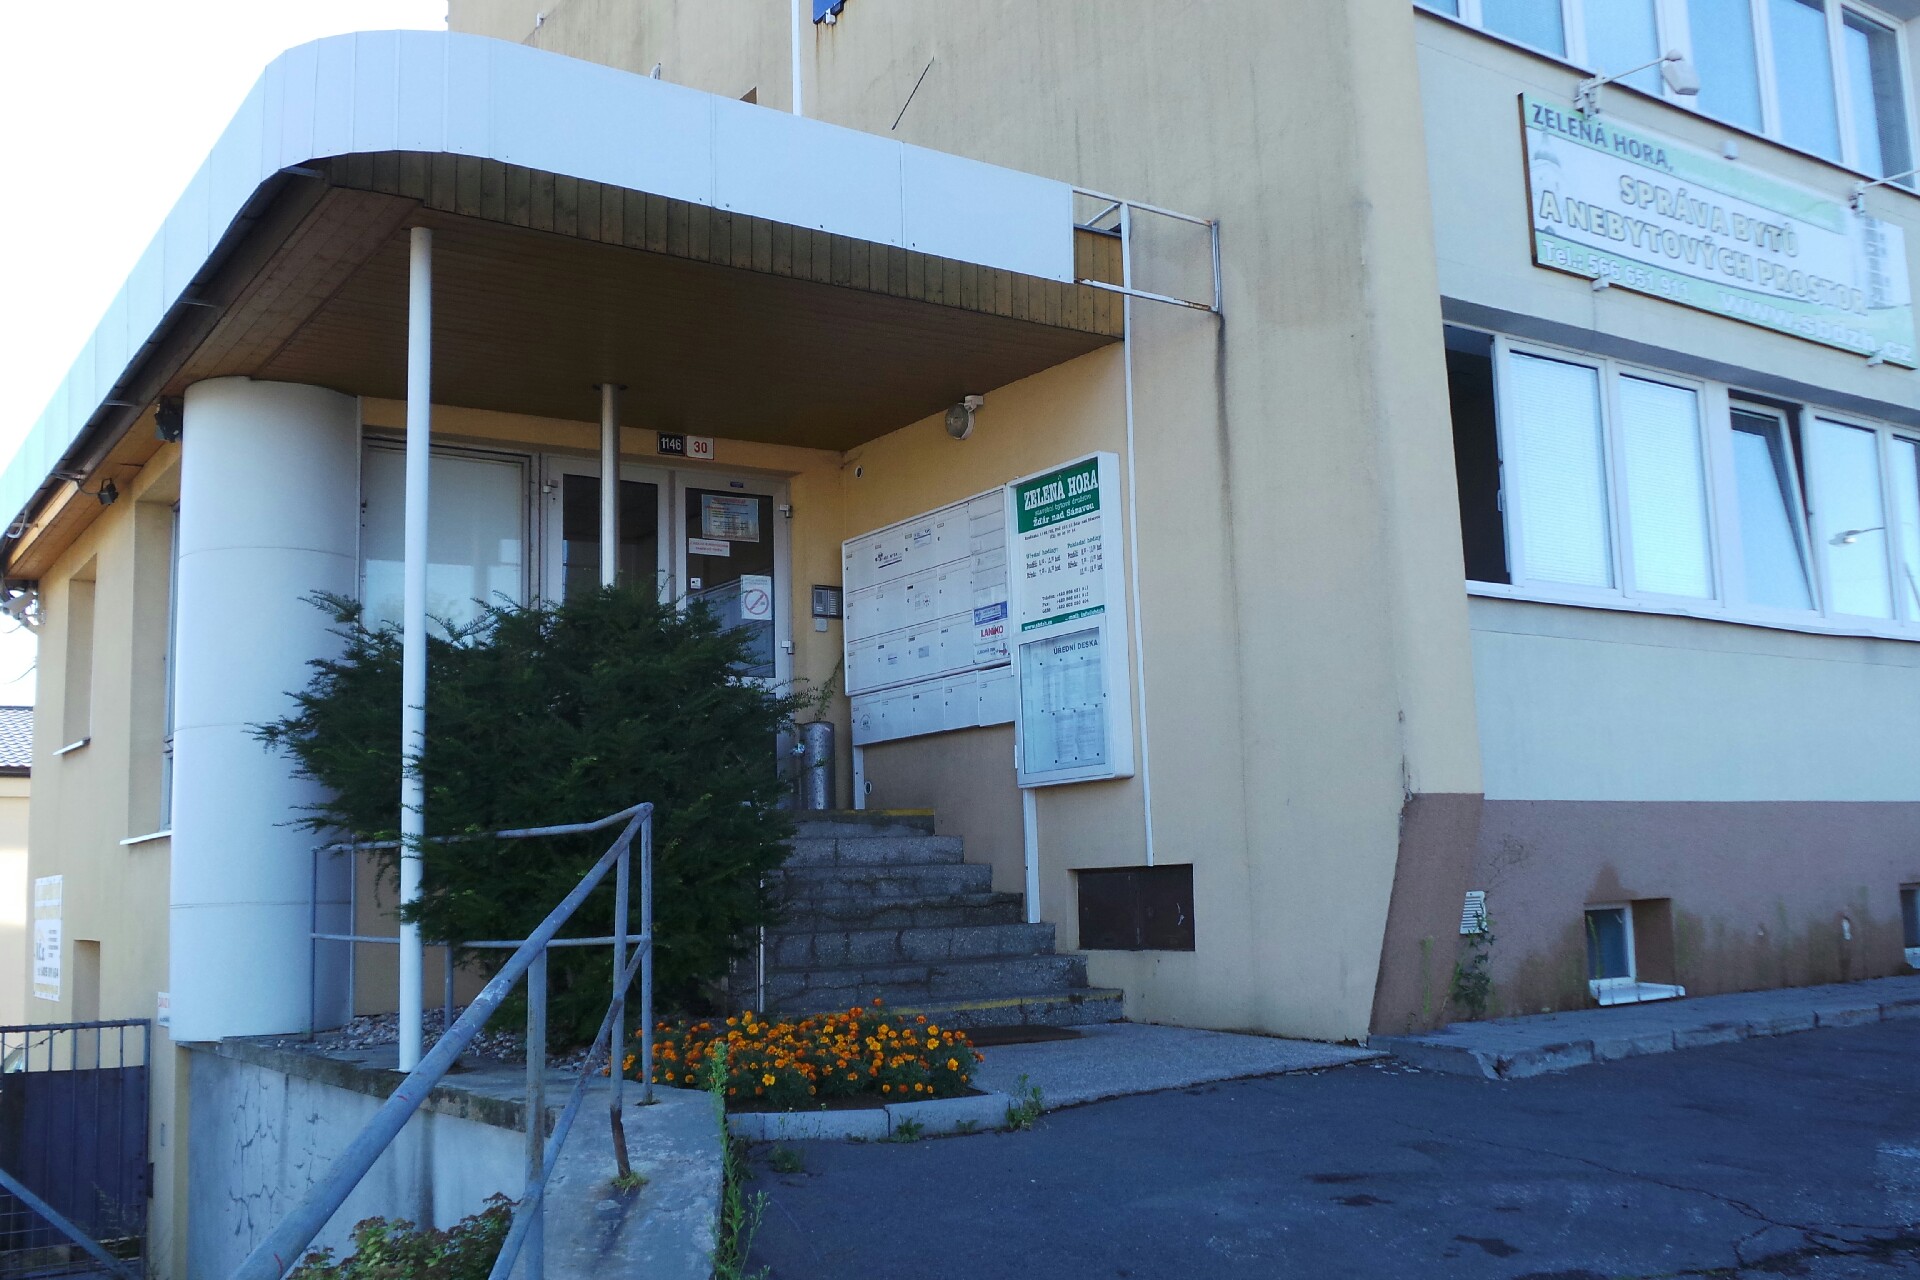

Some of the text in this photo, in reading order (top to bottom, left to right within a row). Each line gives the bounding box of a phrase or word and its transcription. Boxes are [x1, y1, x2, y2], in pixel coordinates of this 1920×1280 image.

[1532, 103, 1675, 173] ZELENÁ HORA,
[1540, 189, 1563, 224] A
[1565, 196, 1754, 283] NEBYTOVÝCH
[1619, 174, 1799, 258] SPRÁVA BYTŮ
[1541, 239, 1584, 271] Tel.:
[1587, 253, 1621, 281] 566
[1624, 264, 1656, 291] 651
[661, 437, 682, 451] 1146
[693, 440, 708, 454] 30
[1023, 469, 1099, 511] ZELENÁ HORA
[1051, 510, 1065, 521] nad
[1066, 502, 1095, 517] Sázavou
[1053, 639, 1099, 655] ÚŘEDNÍ DESKA
